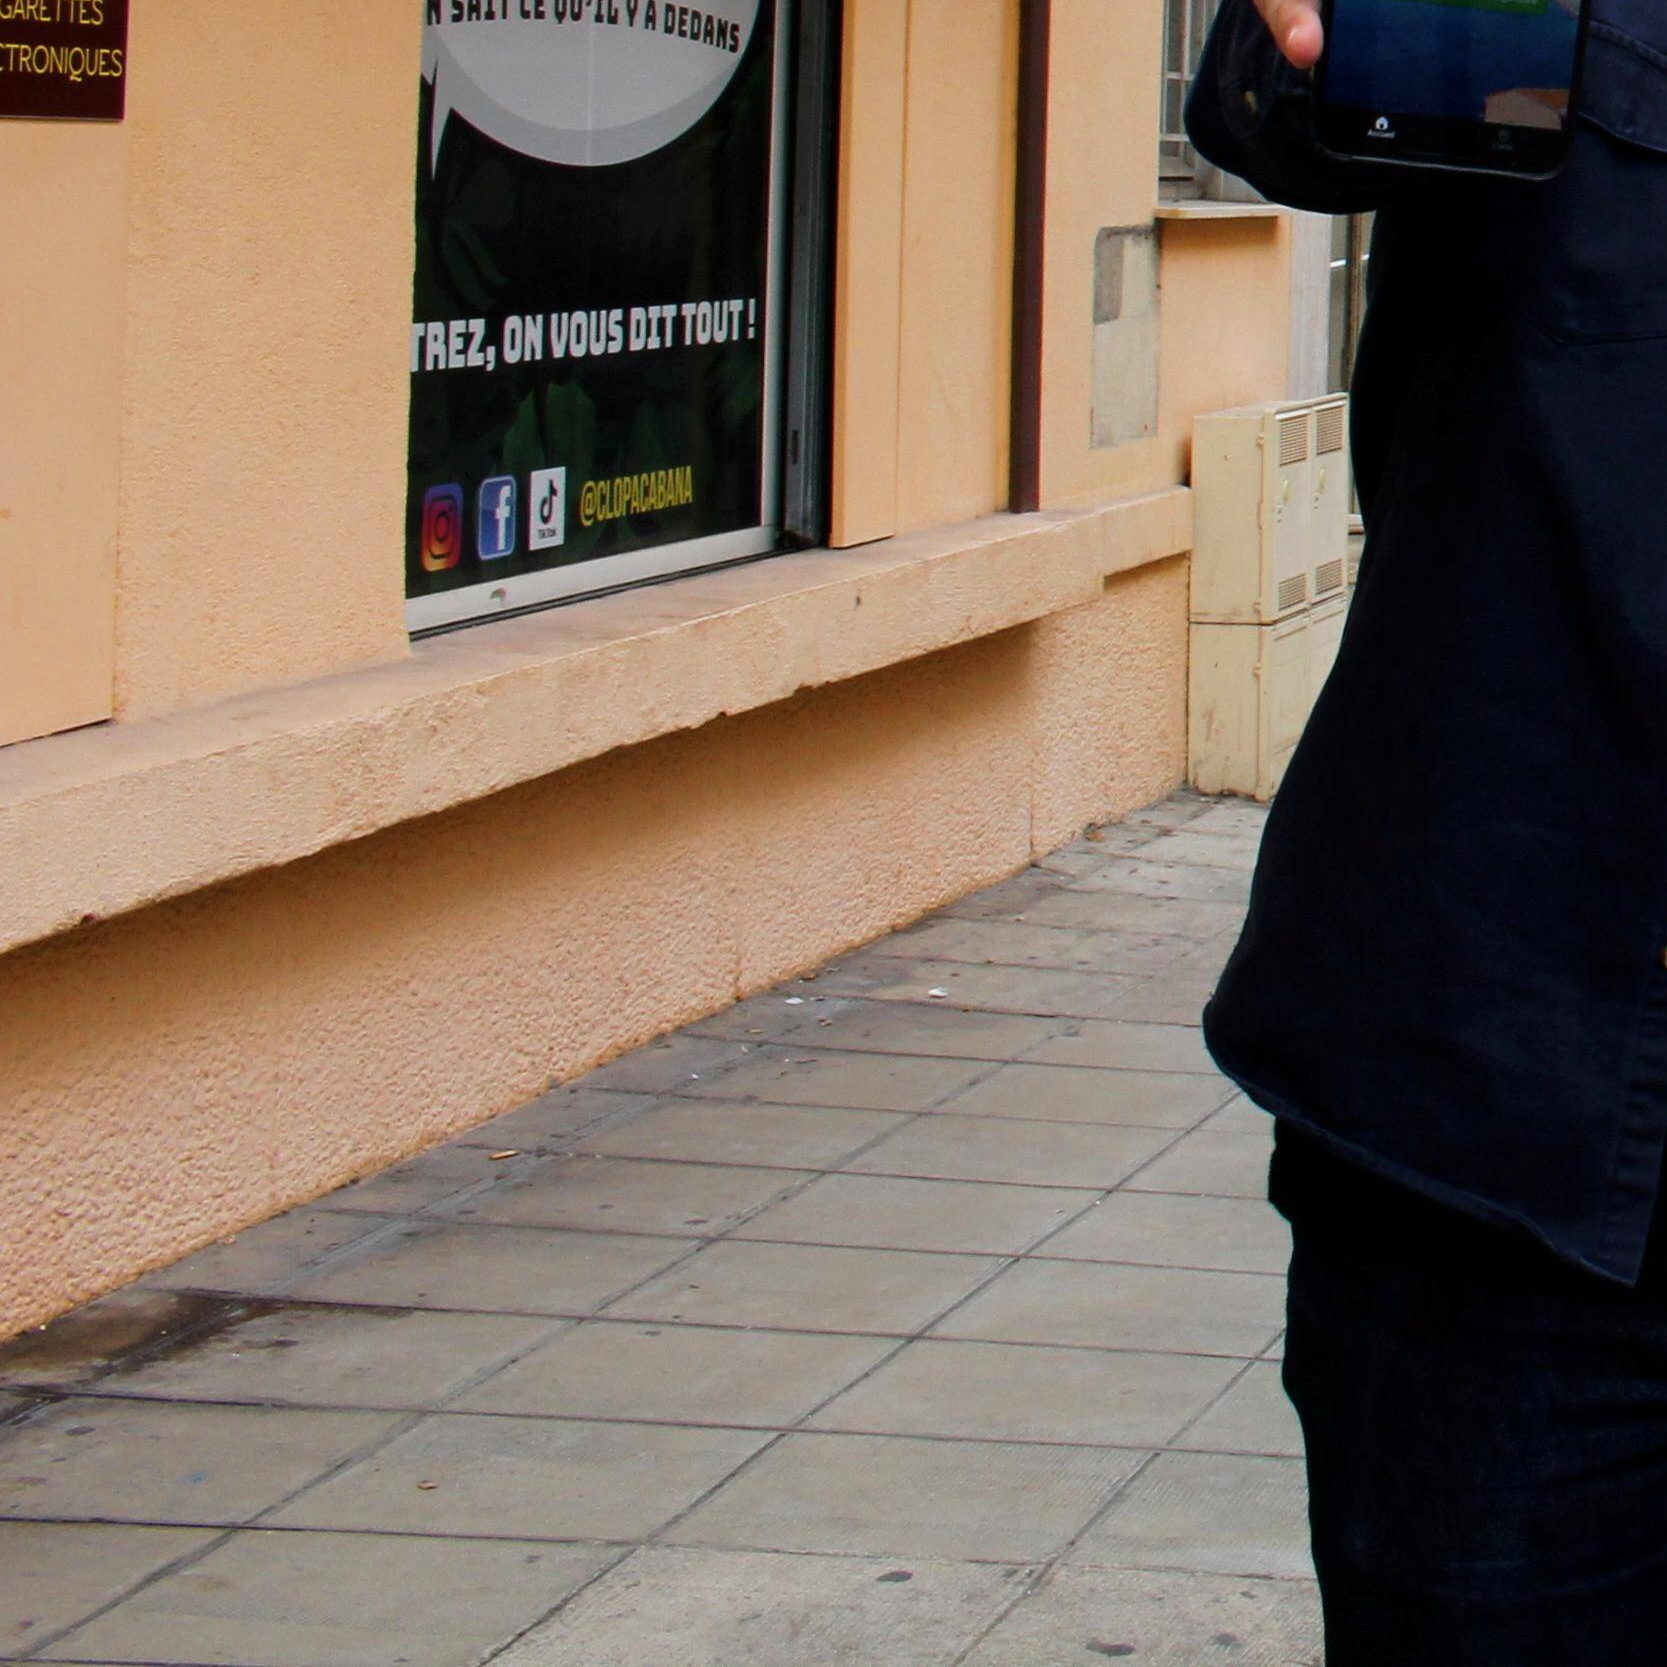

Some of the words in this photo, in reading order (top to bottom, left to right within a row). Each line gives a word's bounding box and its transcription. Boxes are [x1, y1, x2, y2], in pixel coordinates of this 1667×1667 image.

[644, 0, 657, 31] A
[663, 2, 741, 54] DEDANS
[503, 313, 544, 365] ON
[550, 308, 624, 360] VOUS
[629, 303, 678, 353] DIT
[681, 298, 744, 347] TOUT
[580, 464, 694, 528] @CLOPACABANA
